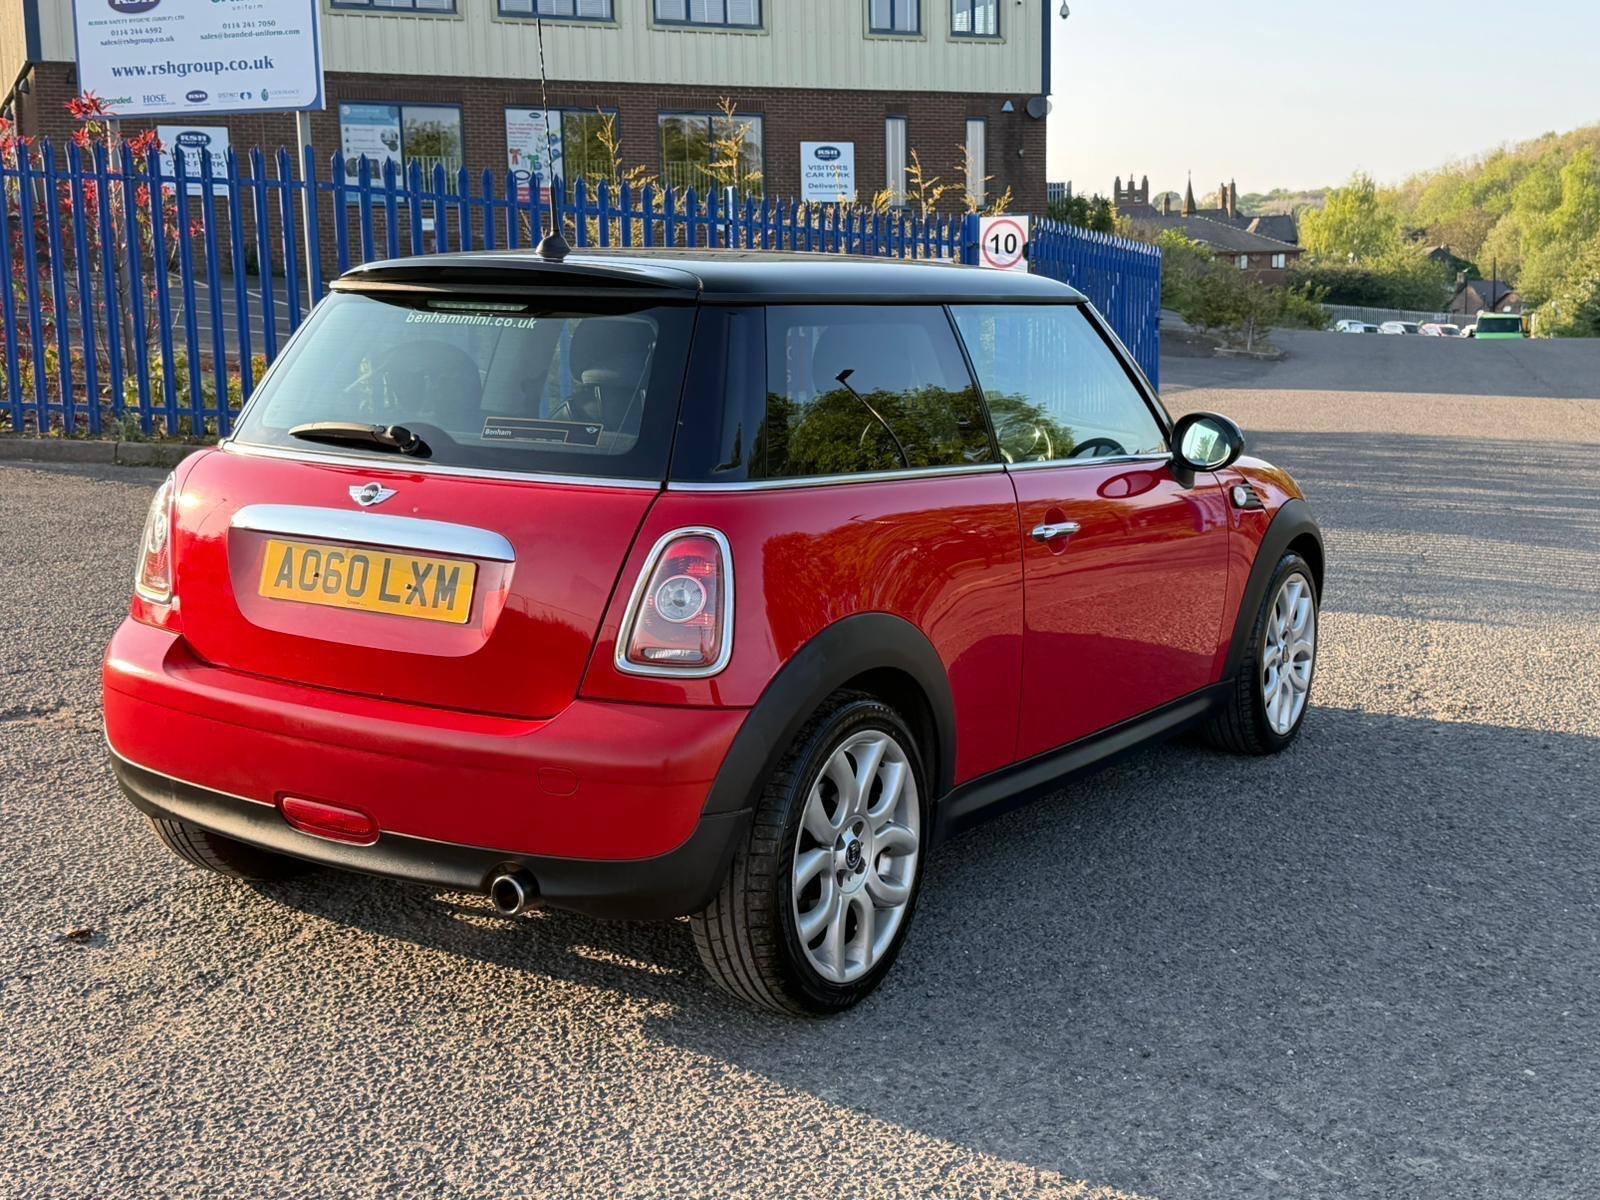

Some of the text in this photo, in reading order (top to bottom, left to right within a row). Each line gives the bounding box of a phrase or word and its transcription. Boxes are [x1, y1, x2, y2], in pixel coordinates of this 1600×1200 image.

[145, 26, 163, 34] 4592
[200, 29, 301, 40] sales@branded-uniform.com
[100, 35, 175, 46] sales@rshgroup.co.uk
[111, 55, 274, 77] www.rshgroup.co.uk
[143, 94, 167, 104] HOSE
[990, 233, 1018, 255] 10
[405, 311, 537, 329] benhammini.co.uk
[485, 428, 512, 437] Benham
[274, 546, 462, 611] AO60 LXM
